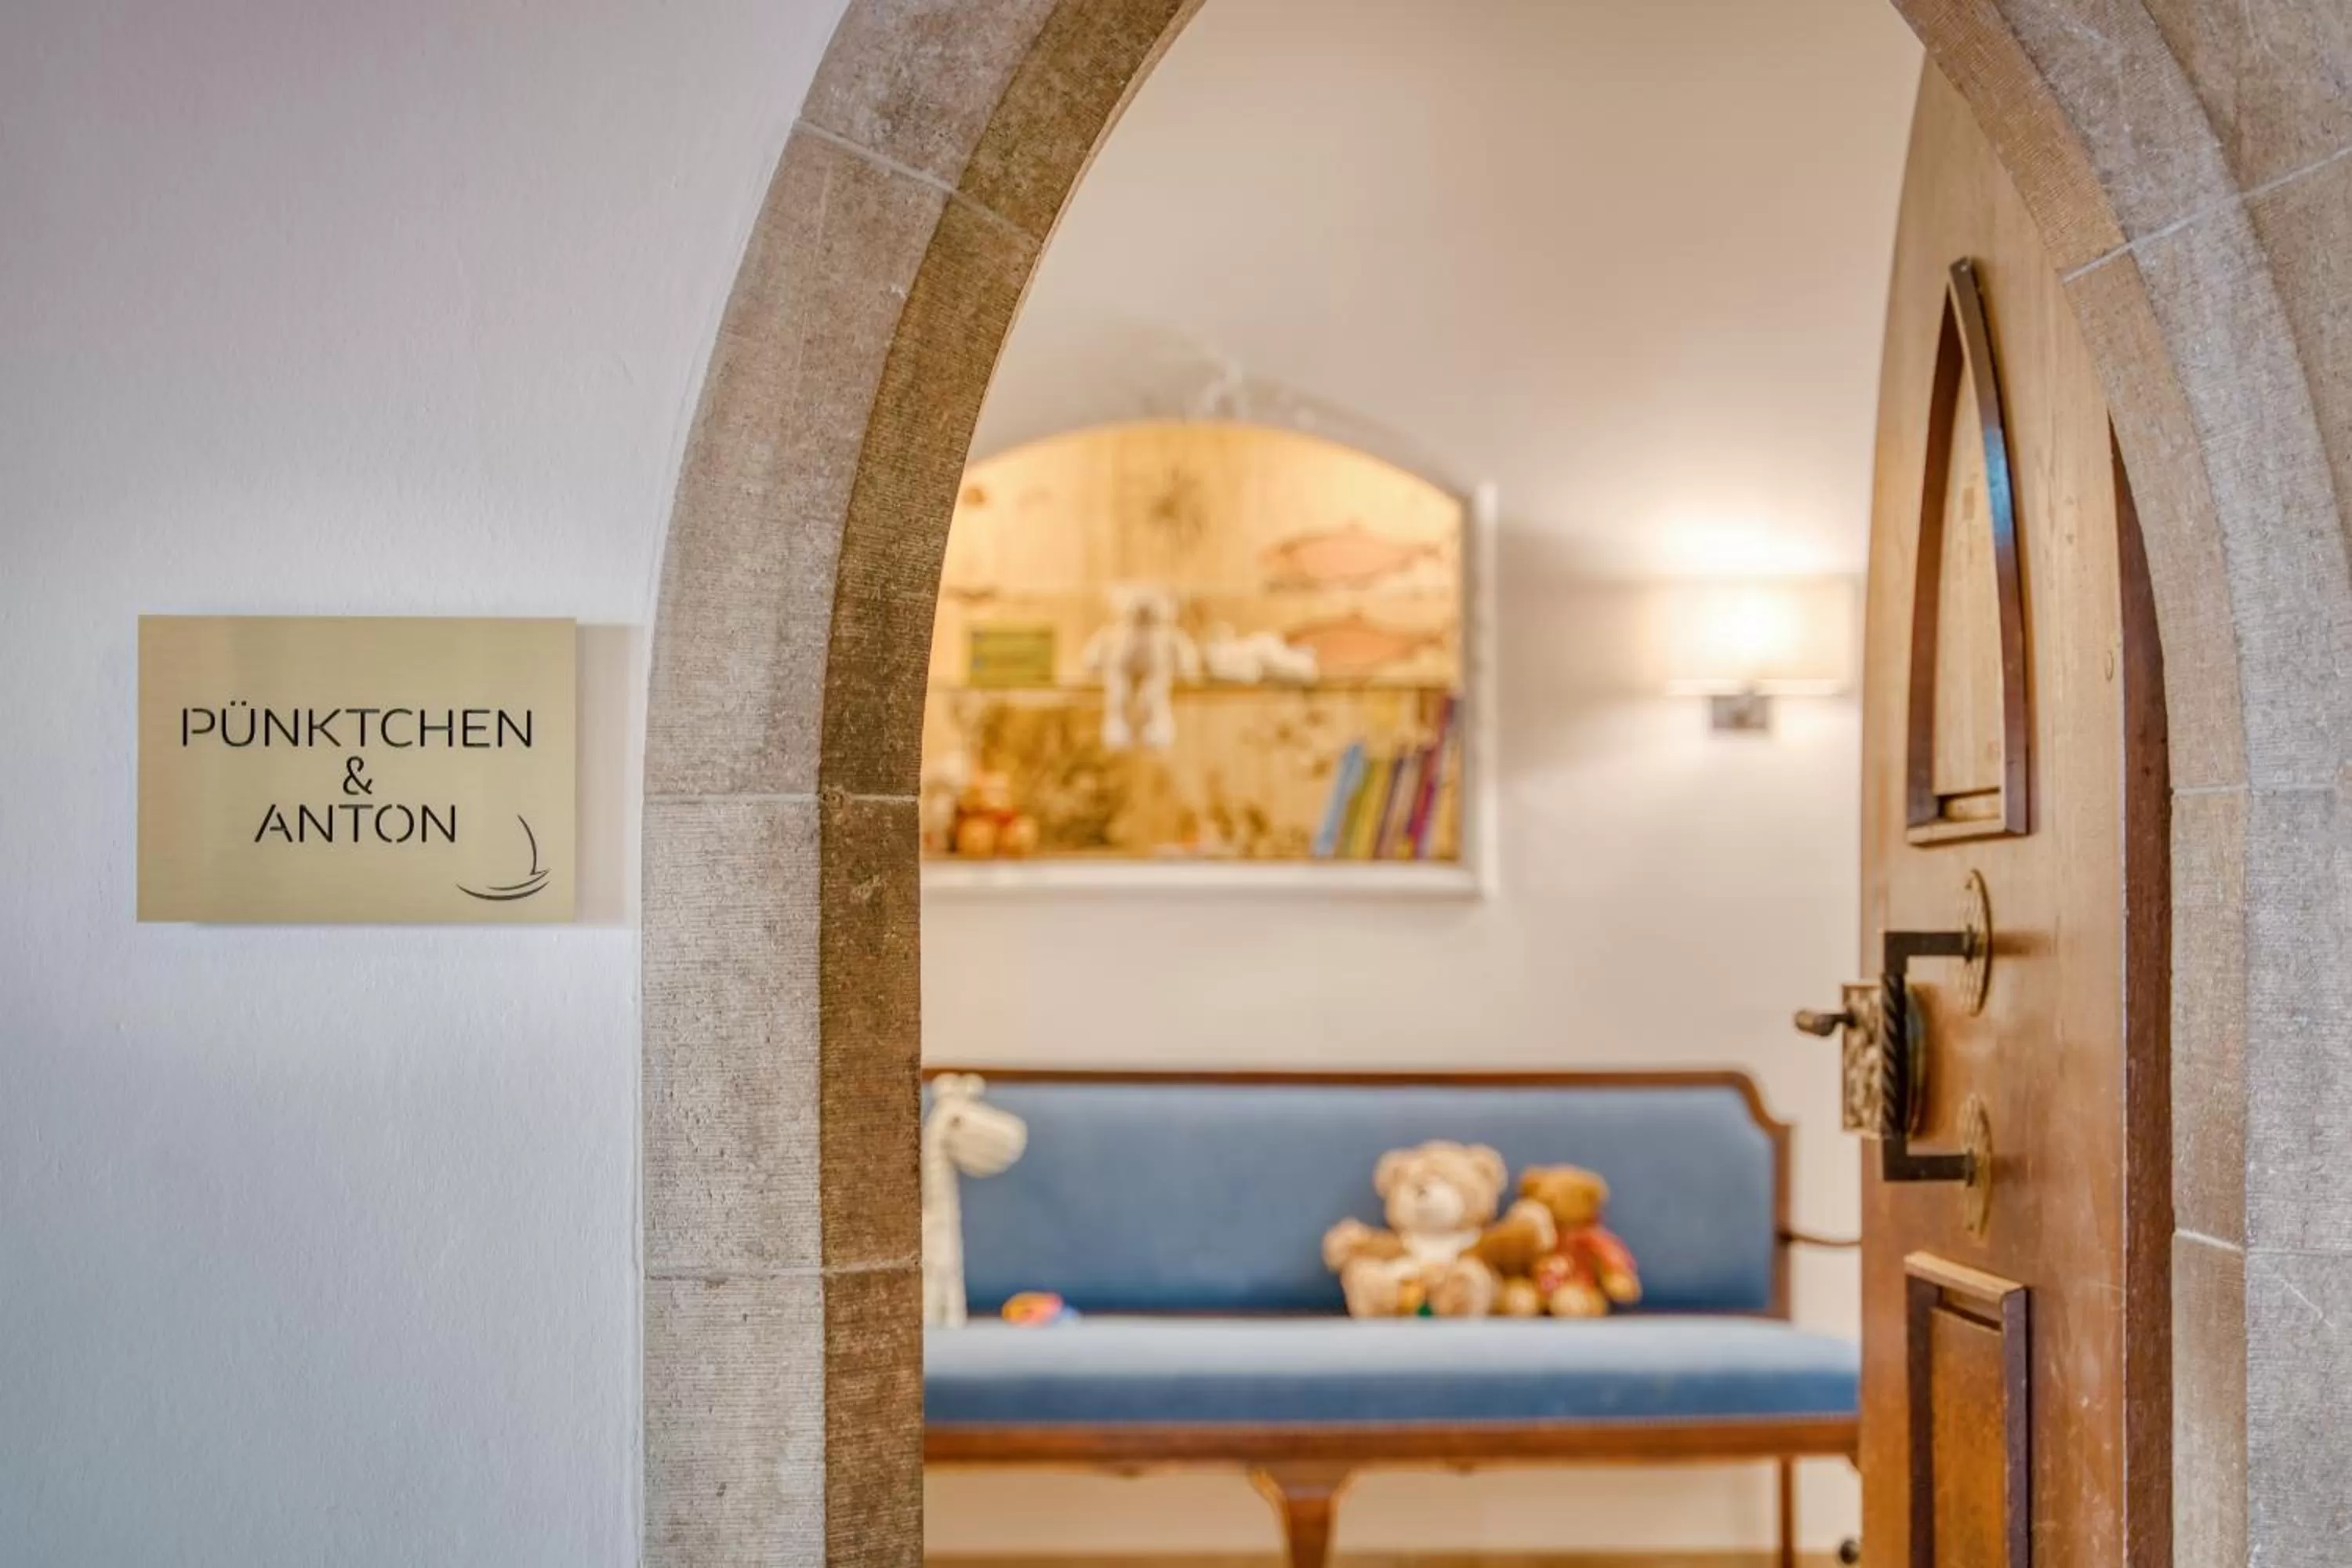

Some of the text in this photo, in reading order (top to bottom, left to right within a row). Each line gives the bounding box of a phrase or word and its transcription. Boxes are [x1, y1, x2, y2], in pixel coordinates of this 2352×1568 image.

[182, 700, 532, 748] PÜNKTCHEN
[343, 756, 373, 796] &
[254, 804, 456, 844] ANTON
